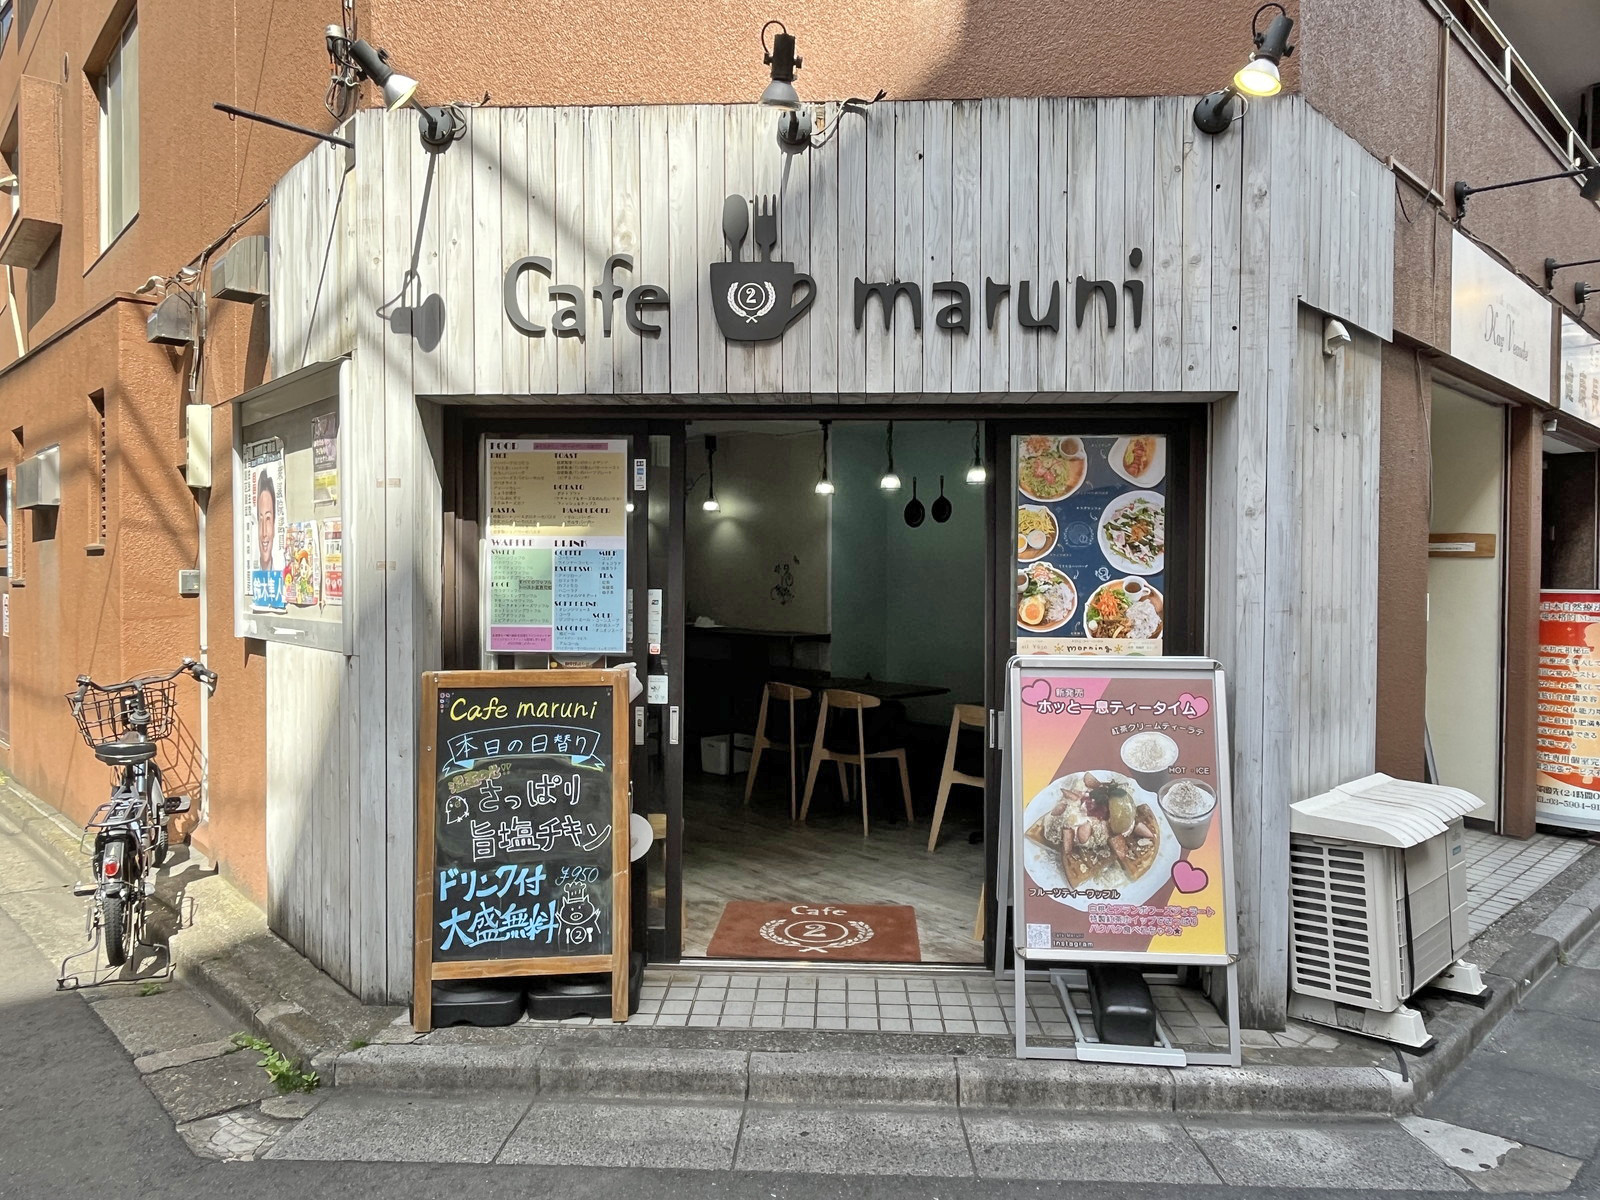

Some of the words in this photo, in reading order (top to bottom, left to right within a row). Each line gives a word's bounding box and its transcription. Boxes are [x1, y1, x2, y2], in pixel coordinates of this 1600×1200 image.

[503, 253, 669, 342] Cafe
[854, 247, 1144, 335] maruni
[1055, 688, 1084, 698] 新発売
[450, 697, 509, 721] Cafe
[516, 701, 598, 720] maruni
[1037, 700, 1197, 716] ホッと一息ティータイム
[1111, 723, 1204, 736] 紅茶クリームティーラテ
[456, 734, 588, 758] 本日の日替り
[479, 774, 580, 812] さっぱり
[471, 815, 612, 863] 旨塩チキン
[439, 865, 547, 901] ドリンク付
[1028, 888, 1121, 899] フルーツティーワッフル
[791, 905, 847, 916] Cafe
[439, 900, 559, 950] 大盛無料
[803, 924, 827, 937] 2
